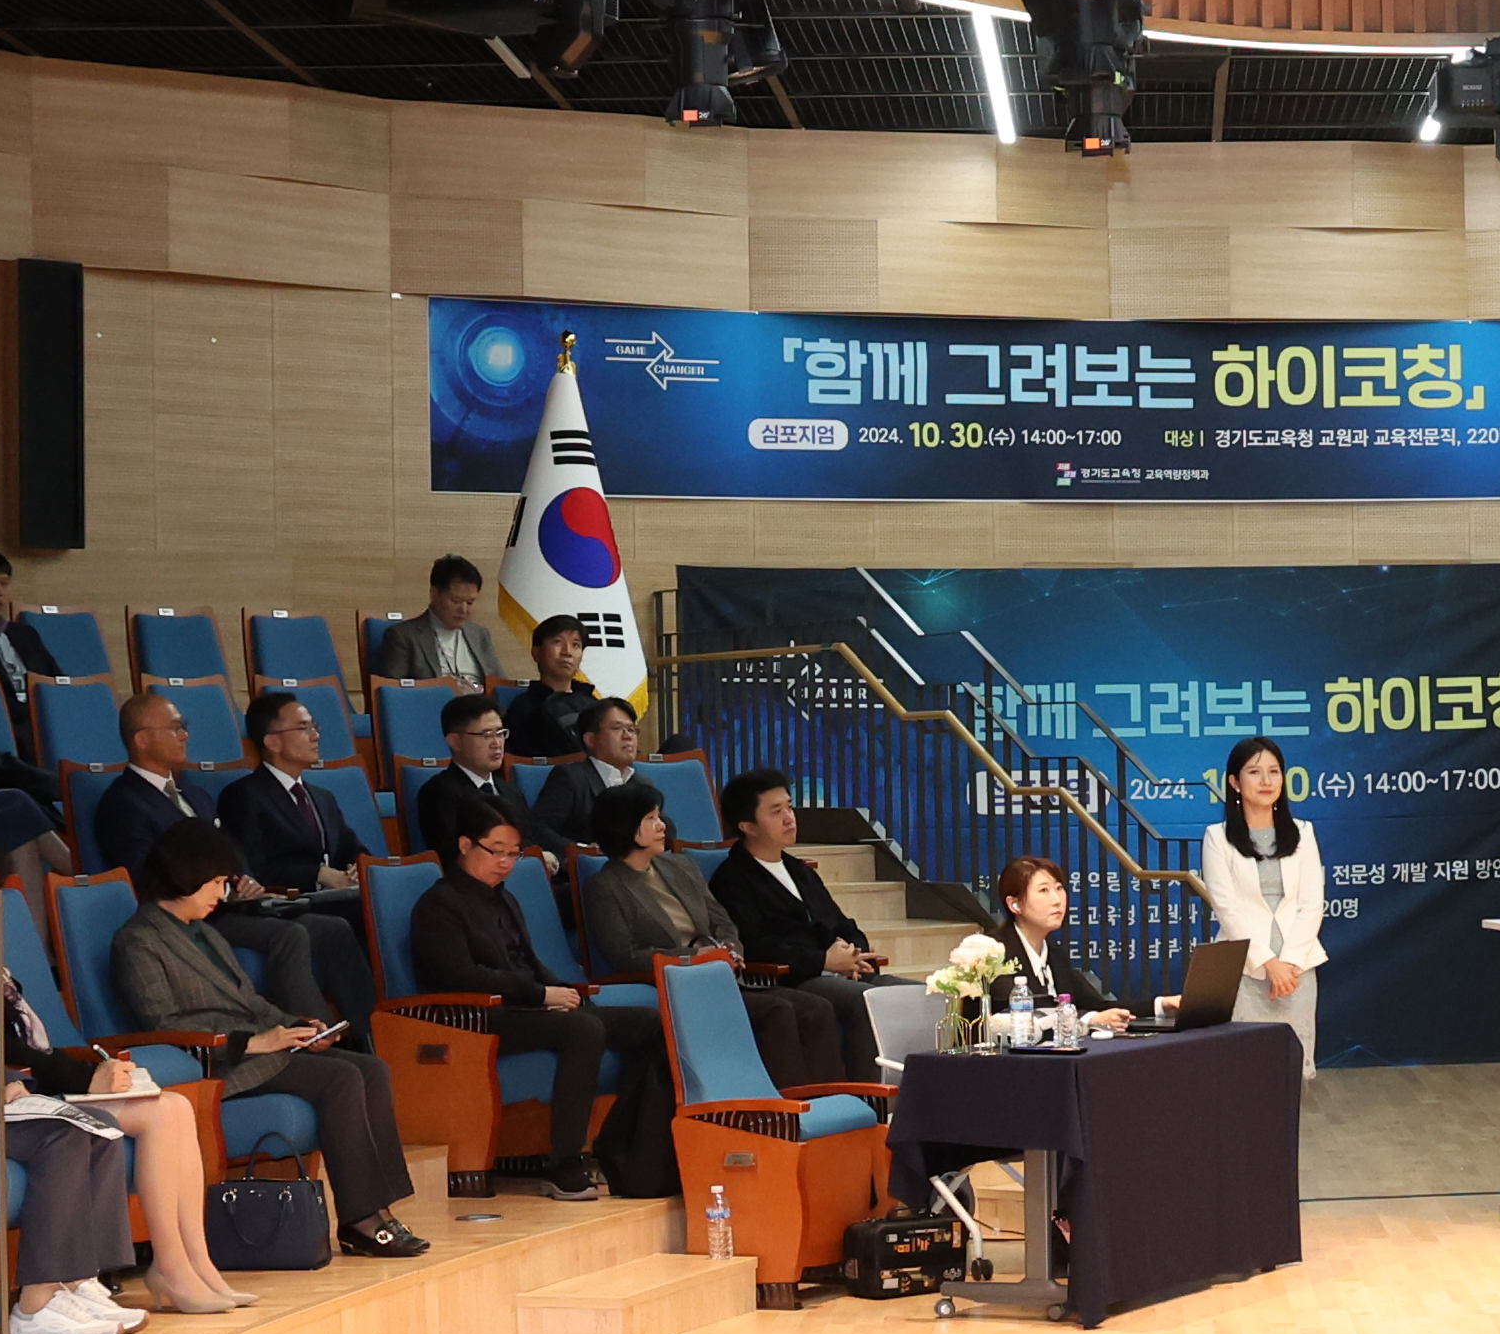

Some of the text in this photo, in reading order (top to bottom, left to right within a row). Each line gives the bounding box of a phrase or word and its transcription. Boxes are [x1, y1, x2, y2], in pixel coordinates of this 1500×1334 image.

[615, 344, 647, 356] GAME
[653, 364, 705, 376] CHANGER
[945, 343, 1196, 409] 그려보는
[760, 423, 836, 446] 심포지엄
[858, 427, 904, 445] 2024.
[908, 421, 945, 448] 10.
[1021, 429, 1122, 447] 14:00~17:00
[1164, 429, 1195, 448] 대상
[1214, 428, 1314, 449] 경기도교육청
[1318, 428, 1369, 448] 교원과
[1373, 428, 1462, 449] 교육전문직,
[1081, 468, 1141, 478] 경기도교육청
[1093, 680, 1311, 739] 그려보는
[1130, 777, 1195, 801] 2024.
[1332, 863, 1386, 886] 전문성
[1392, 862, 1428, 884] 개발
[1433, 859, 1470, 881] 지원
